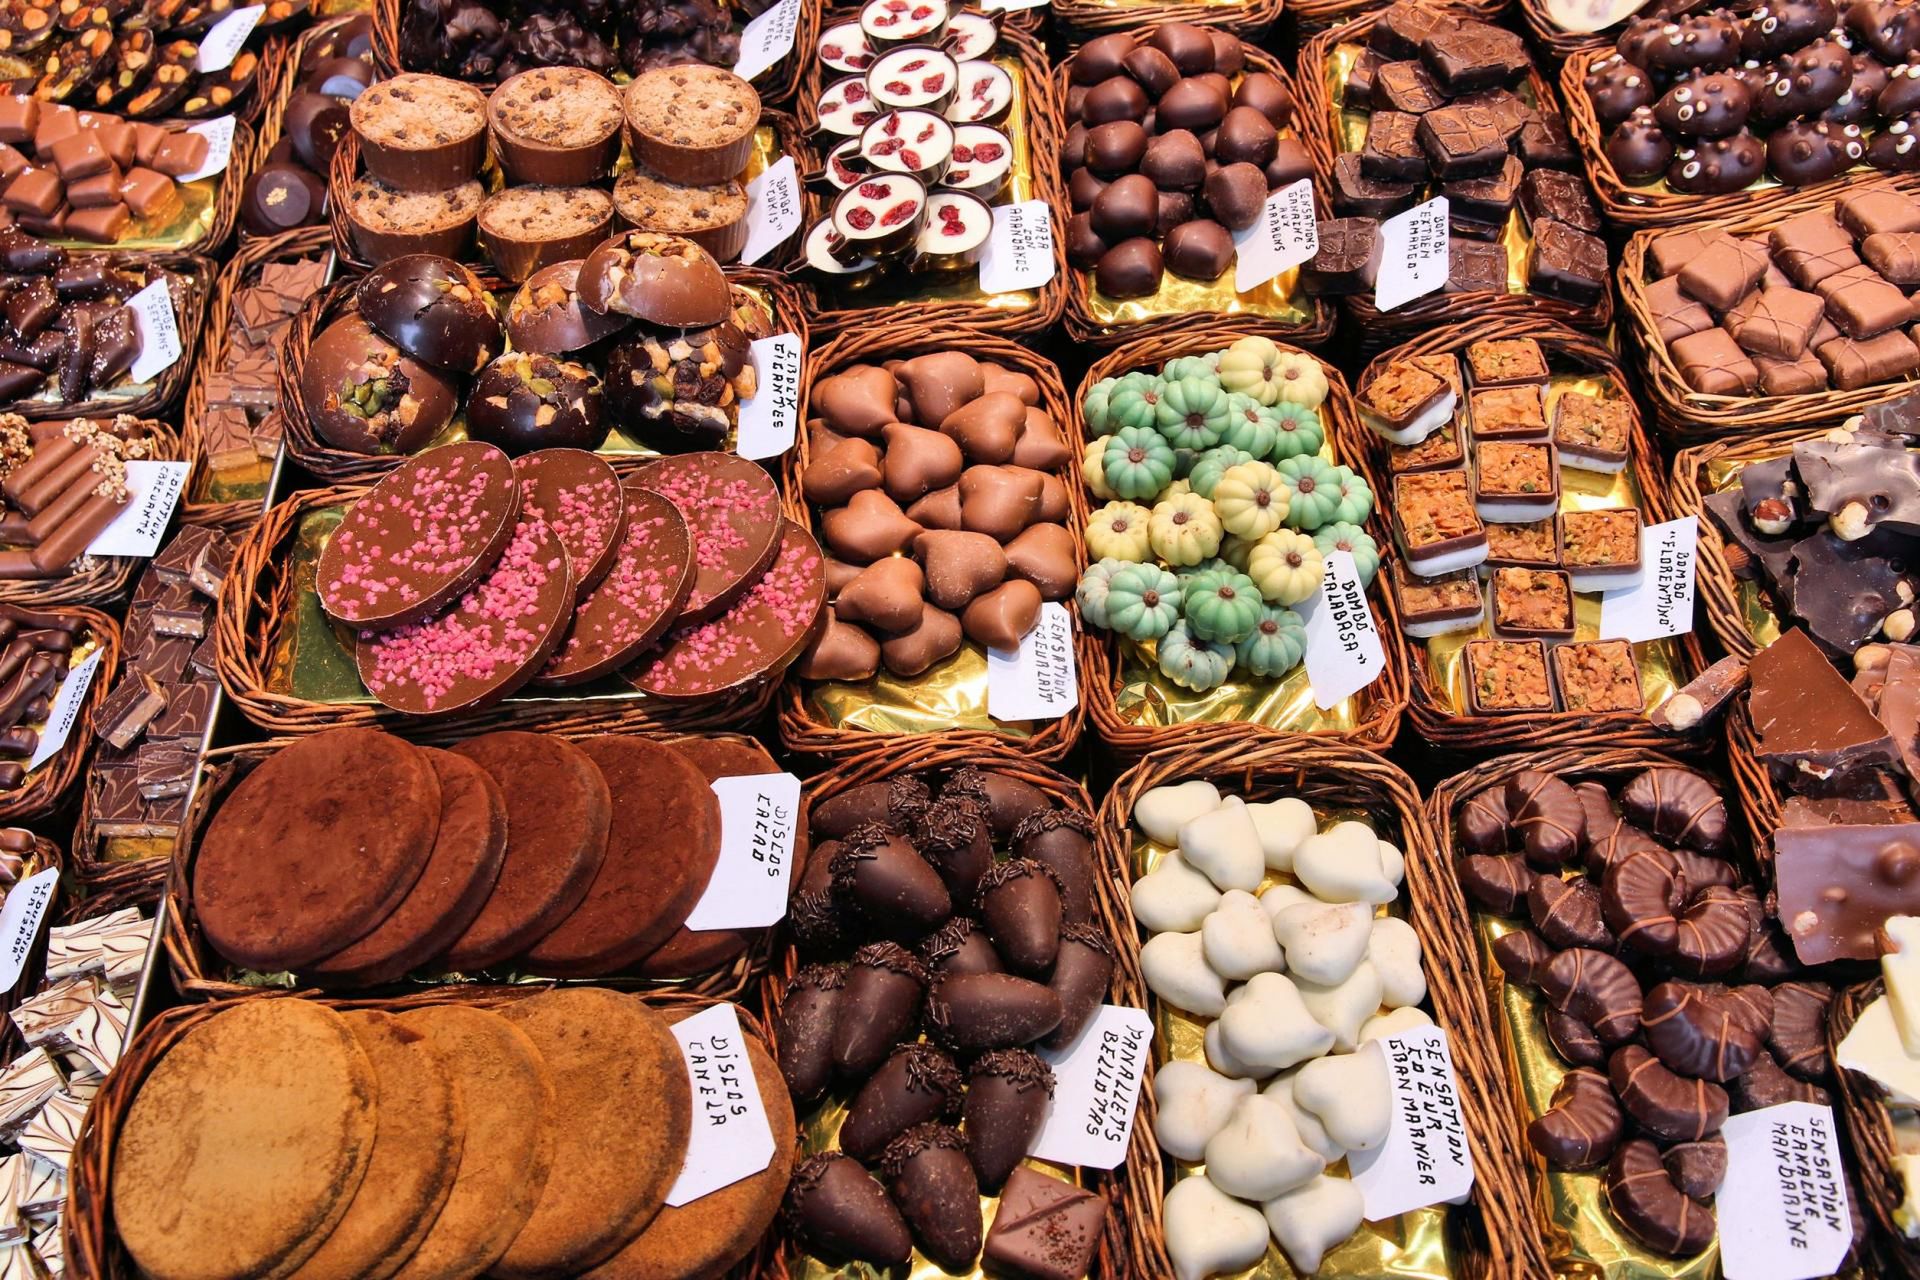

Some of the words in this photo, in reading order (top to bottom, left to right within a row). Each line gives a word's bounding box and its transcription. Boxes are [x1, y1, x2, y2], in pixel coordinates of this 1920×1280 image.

[776, 177, 793, 215] BOMBÓ
[1035, 216, 1049, 249] TAZA
[1267, 203, 1286, 251] MARRONS
[1280, 207, 1290, 227] AUX
[1300, 186, 1315, 250] SENSATIONS
[1010, 208, 1029, 272] ARANDANOS
[1024, 229, 1036, 249] CON
[772, 344, 786, 428] GIGANTES
[1342, 580, 1374, 632] BOMBÓ
[1674, 552, 1690, 601] BOMBÓ
[1051, 614, 1070, 699] SENSATION
[752, 793, 771, 862] CACAO
[767, 805, 790, 877] DISCOS
[15, 882, 51, 966] SEDUCTION
[689, 1041, 727, 1126] CANELA
[711, 1036, 747, 1115] DISCOS
[1086, 1030, 1119, 1136] BELLOTAS
[1389, 1039, 1412, 1091] GRAN
[1401, 1097, 1436, 1185] MARNIER
[1423, 1038, 1464, 1166] SENSATION
[1772, 1121, 1808, 1248] MANDARINE
[1791, 1124, 1820, 1219] GANACHE
[1810, 1117, 1843, 1231] SENSATION
